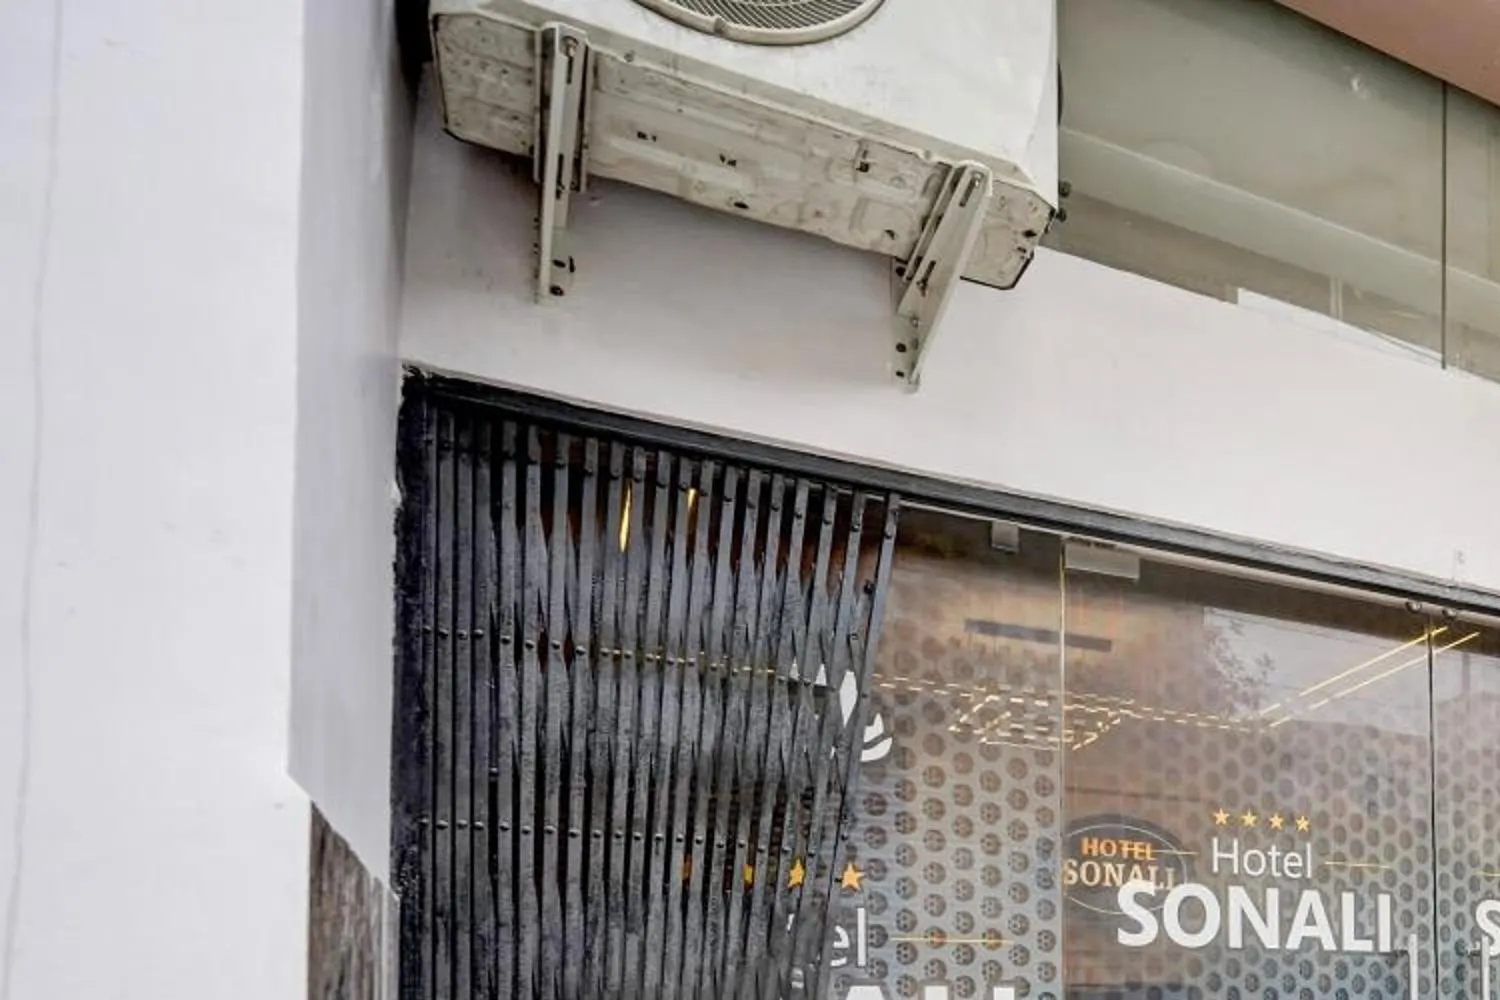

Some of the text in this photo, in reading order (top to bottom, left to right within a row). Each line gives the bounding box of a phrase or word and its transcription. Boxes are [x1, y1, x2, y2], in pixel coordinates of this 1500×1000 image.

[1081, 837, 1157, 860] HOTEL
[1212, 837, 1313, 879] Hotel
[1063, 858, 1176, 890] SONALI
[1116, 879, 1391, 951] SONALI
